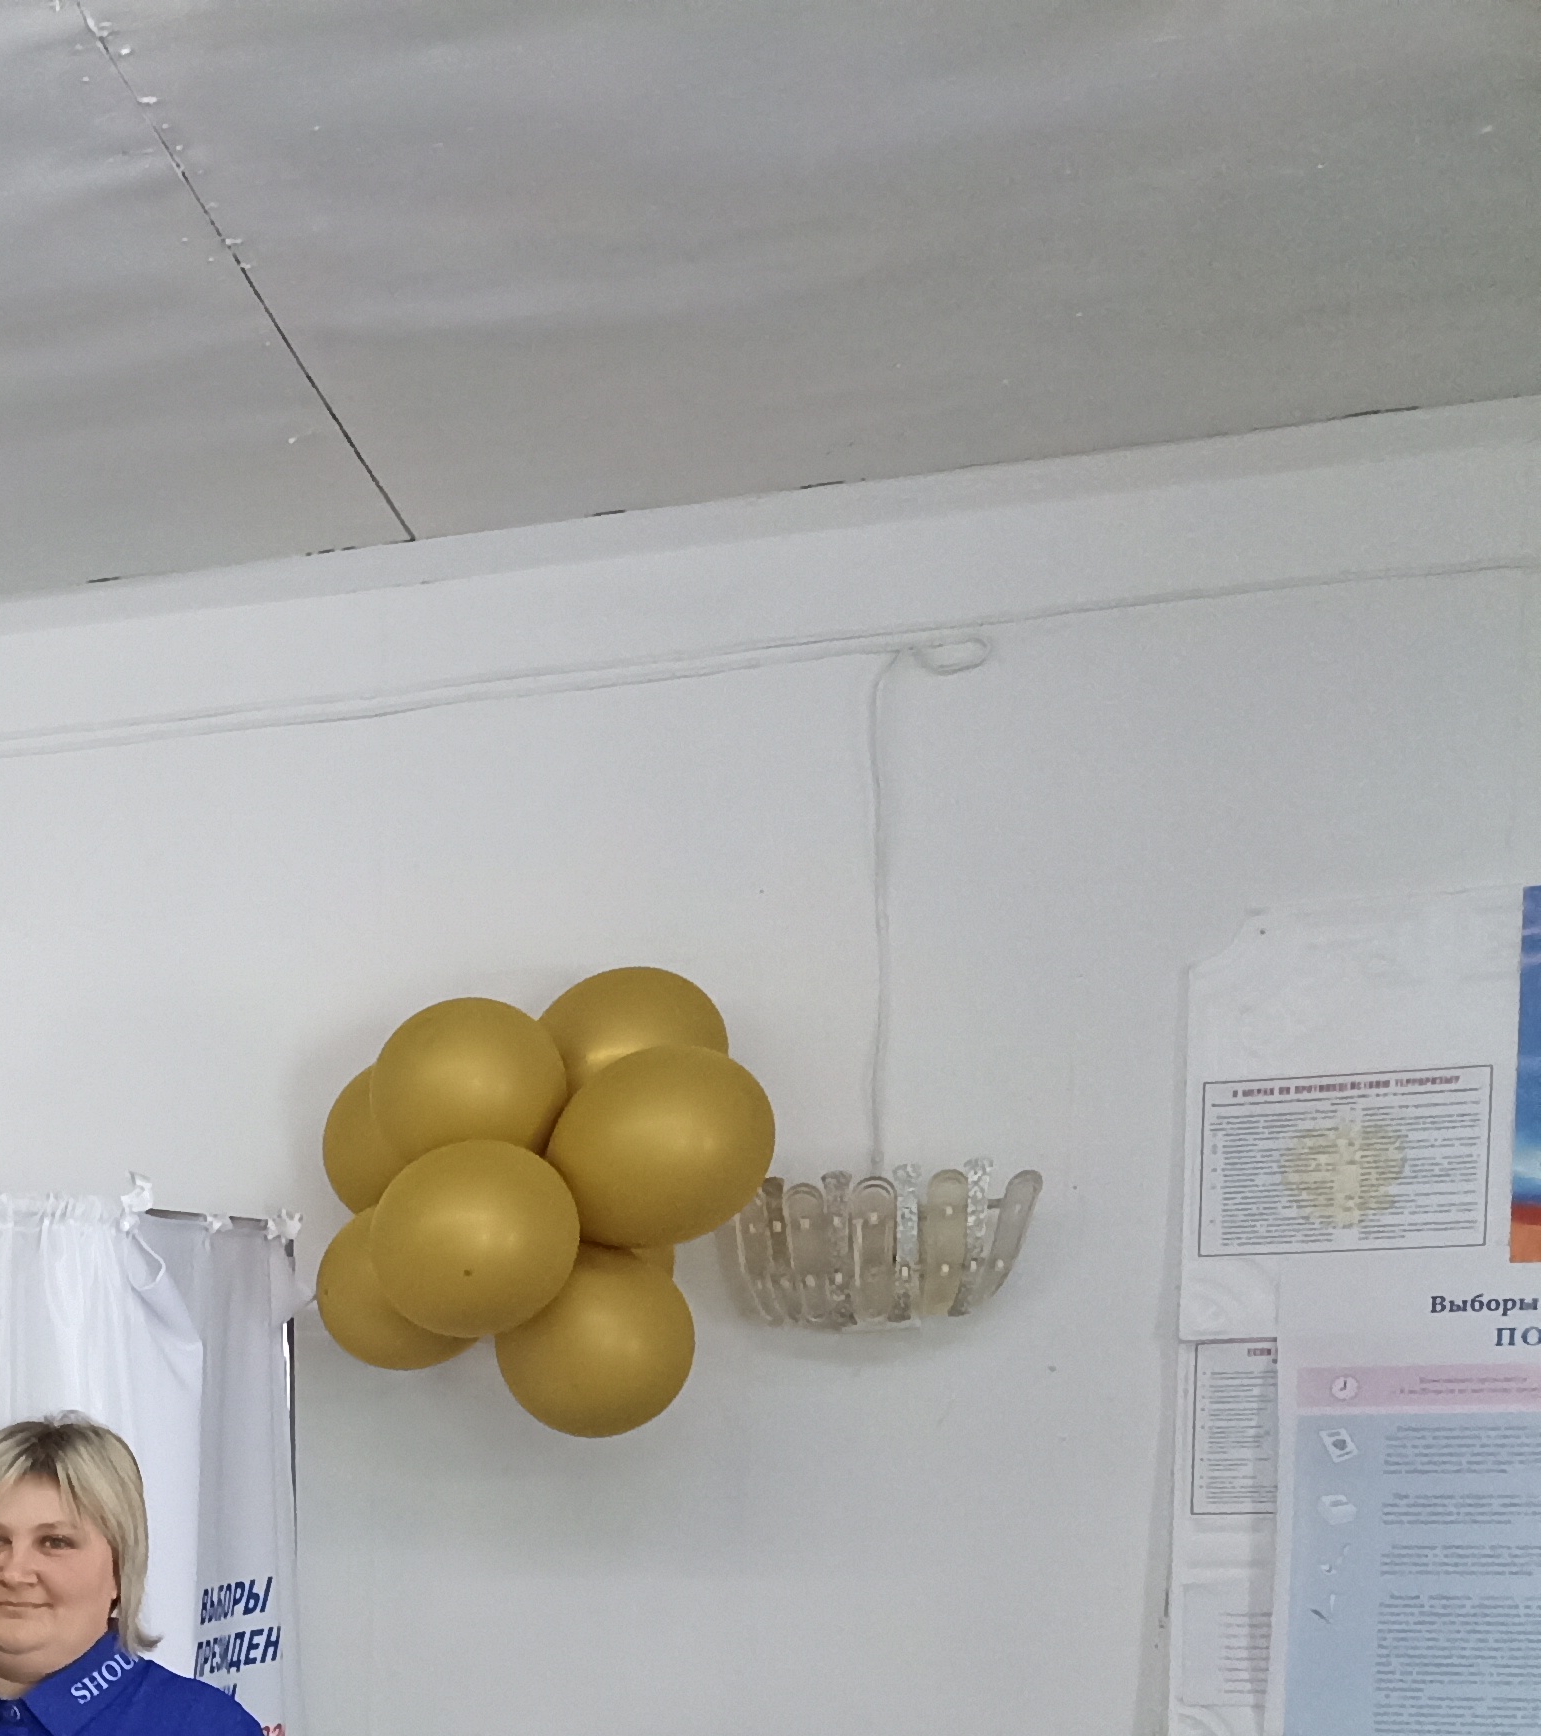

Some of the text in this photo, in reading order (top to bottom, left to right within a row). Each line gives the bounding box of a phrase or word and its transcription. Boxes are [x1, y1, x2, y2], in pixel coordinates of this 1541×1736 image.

[1430, 1293, 1539, 1317] Выборы
[1495, 1326, 1541, 1347] ПО
[70, 1654, 139, 1705] SHOU
